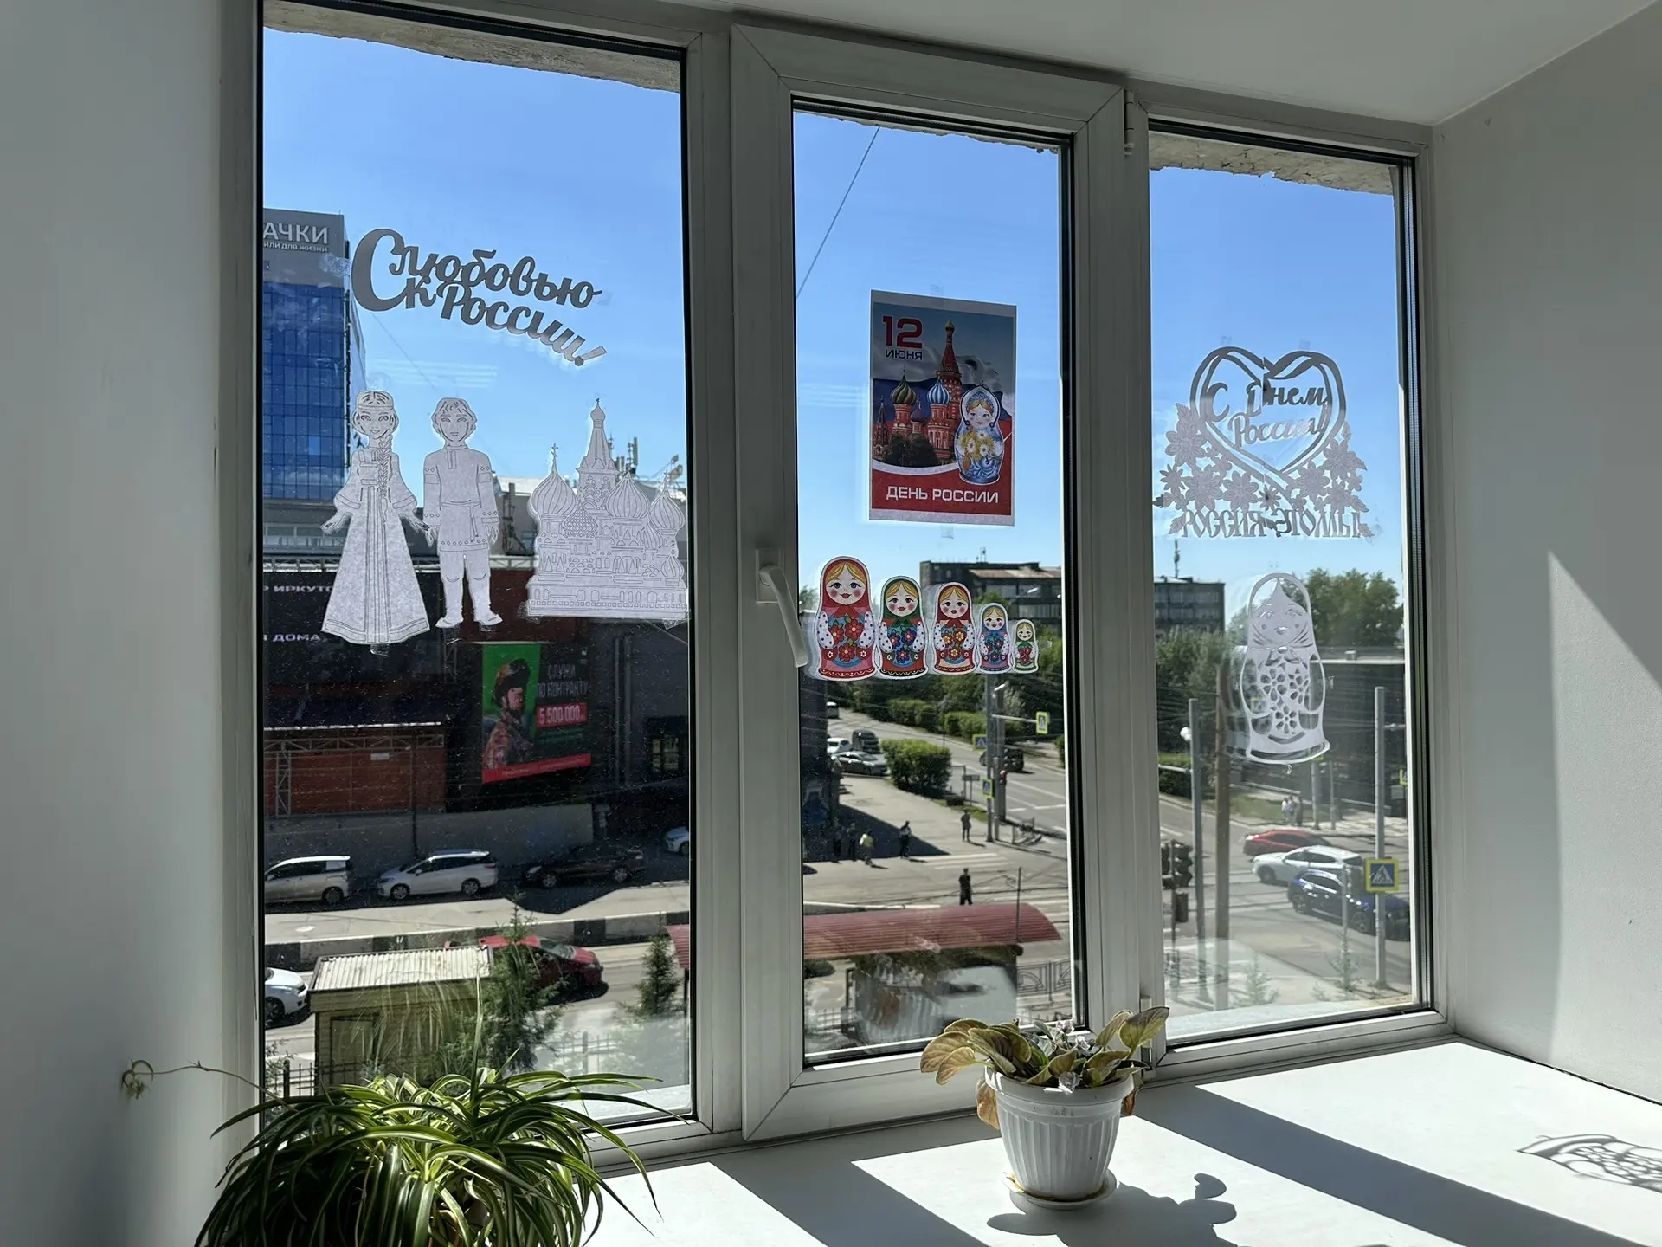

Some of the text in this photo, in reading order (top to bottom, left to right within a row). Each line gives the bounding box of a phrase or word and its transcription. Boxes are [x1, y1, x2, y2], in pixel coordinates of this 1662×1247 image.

[263, 222, 328, 244] АЧКИ
[882, 315, 923, 349] 12
[885, 349, 923, 361] ИЮНЯ
[885, 486, 999, 504] ДЕНЬ РОССИИ
